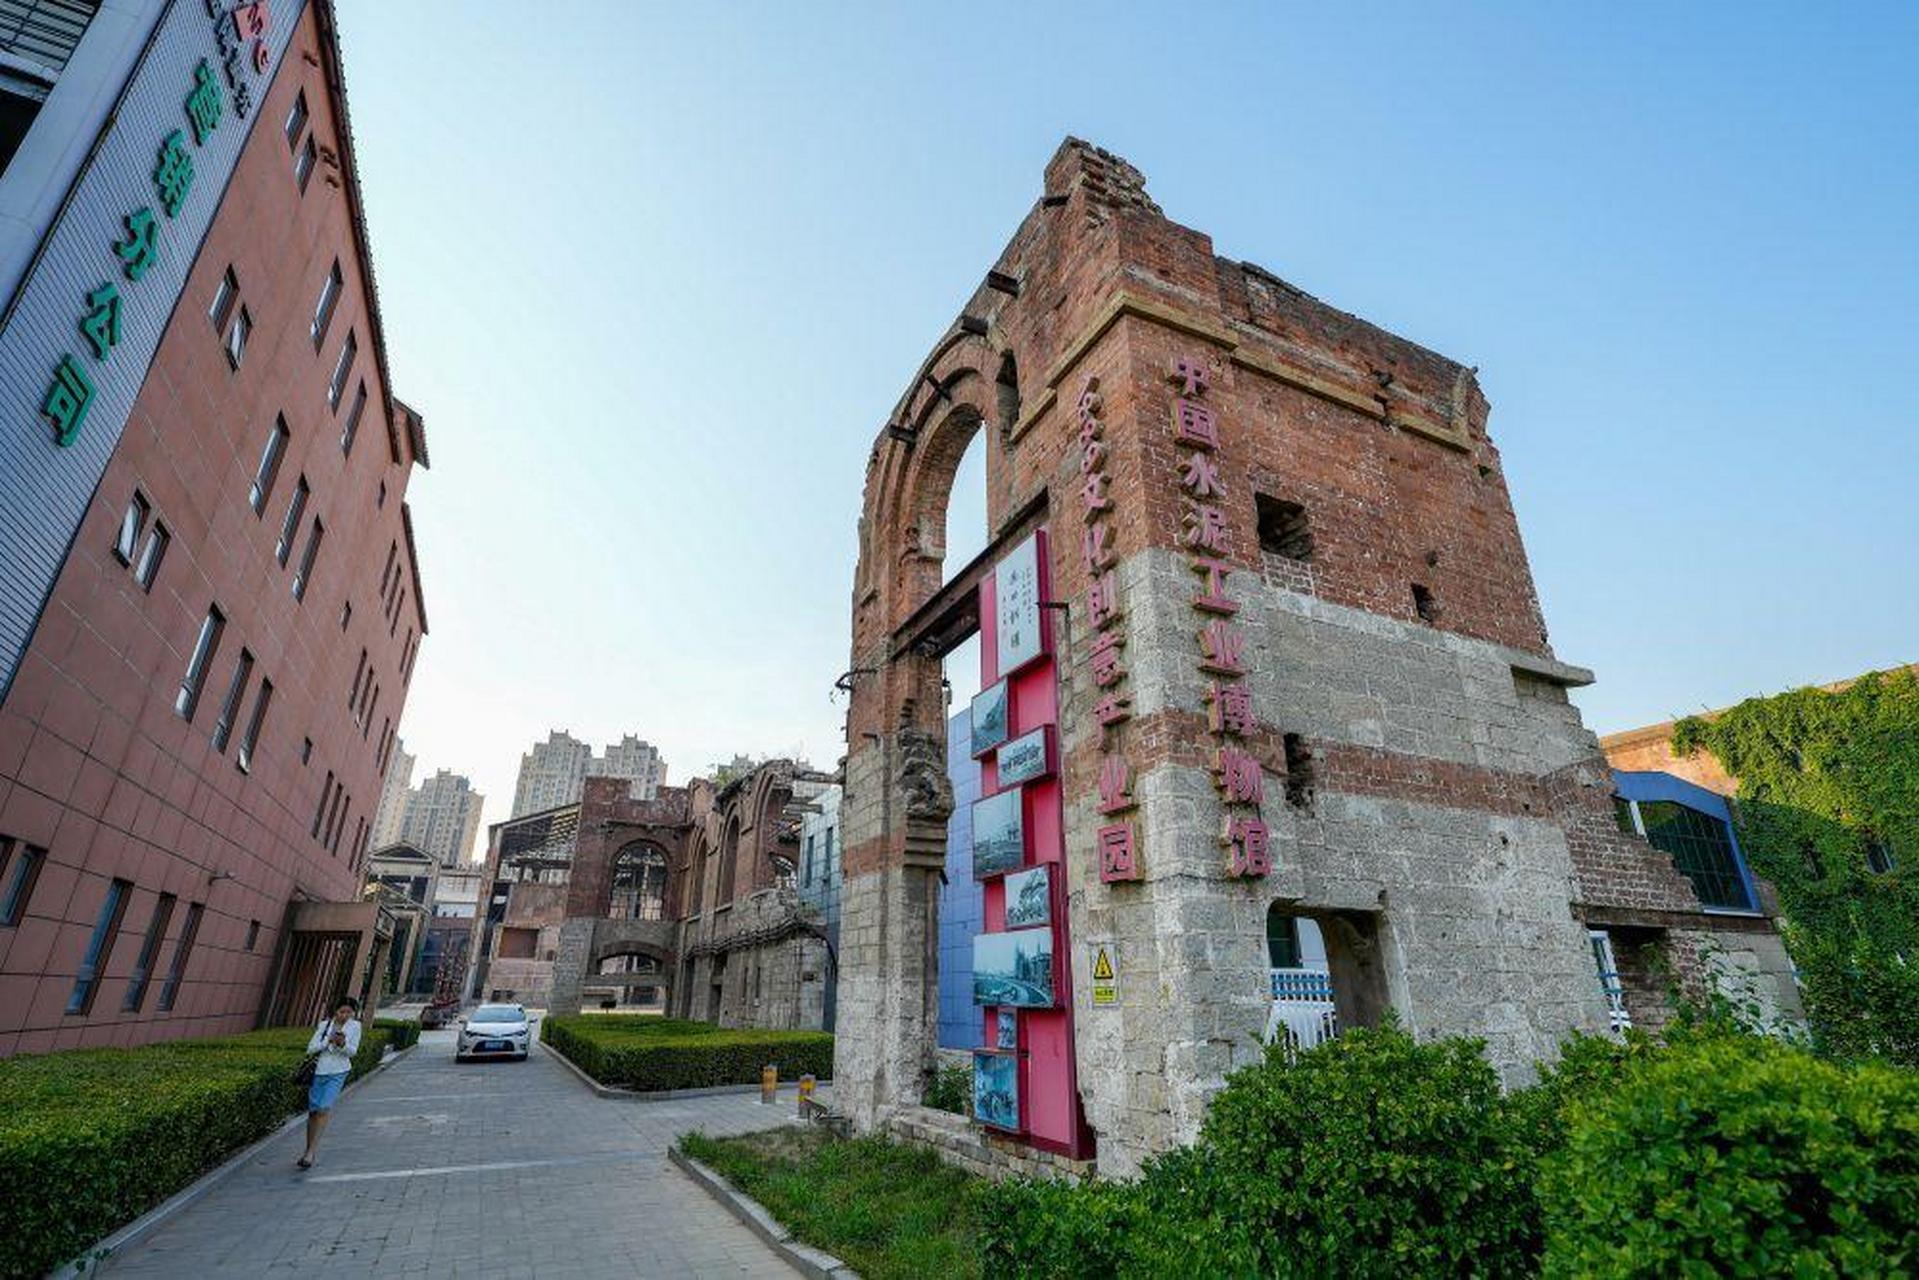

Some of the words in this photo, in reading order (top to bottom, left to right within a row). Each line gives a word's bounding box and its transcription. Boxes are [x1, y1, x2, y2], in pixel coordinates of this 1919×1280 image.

[1171, 356, 1271, 878] 中国水泥工业博物馆
